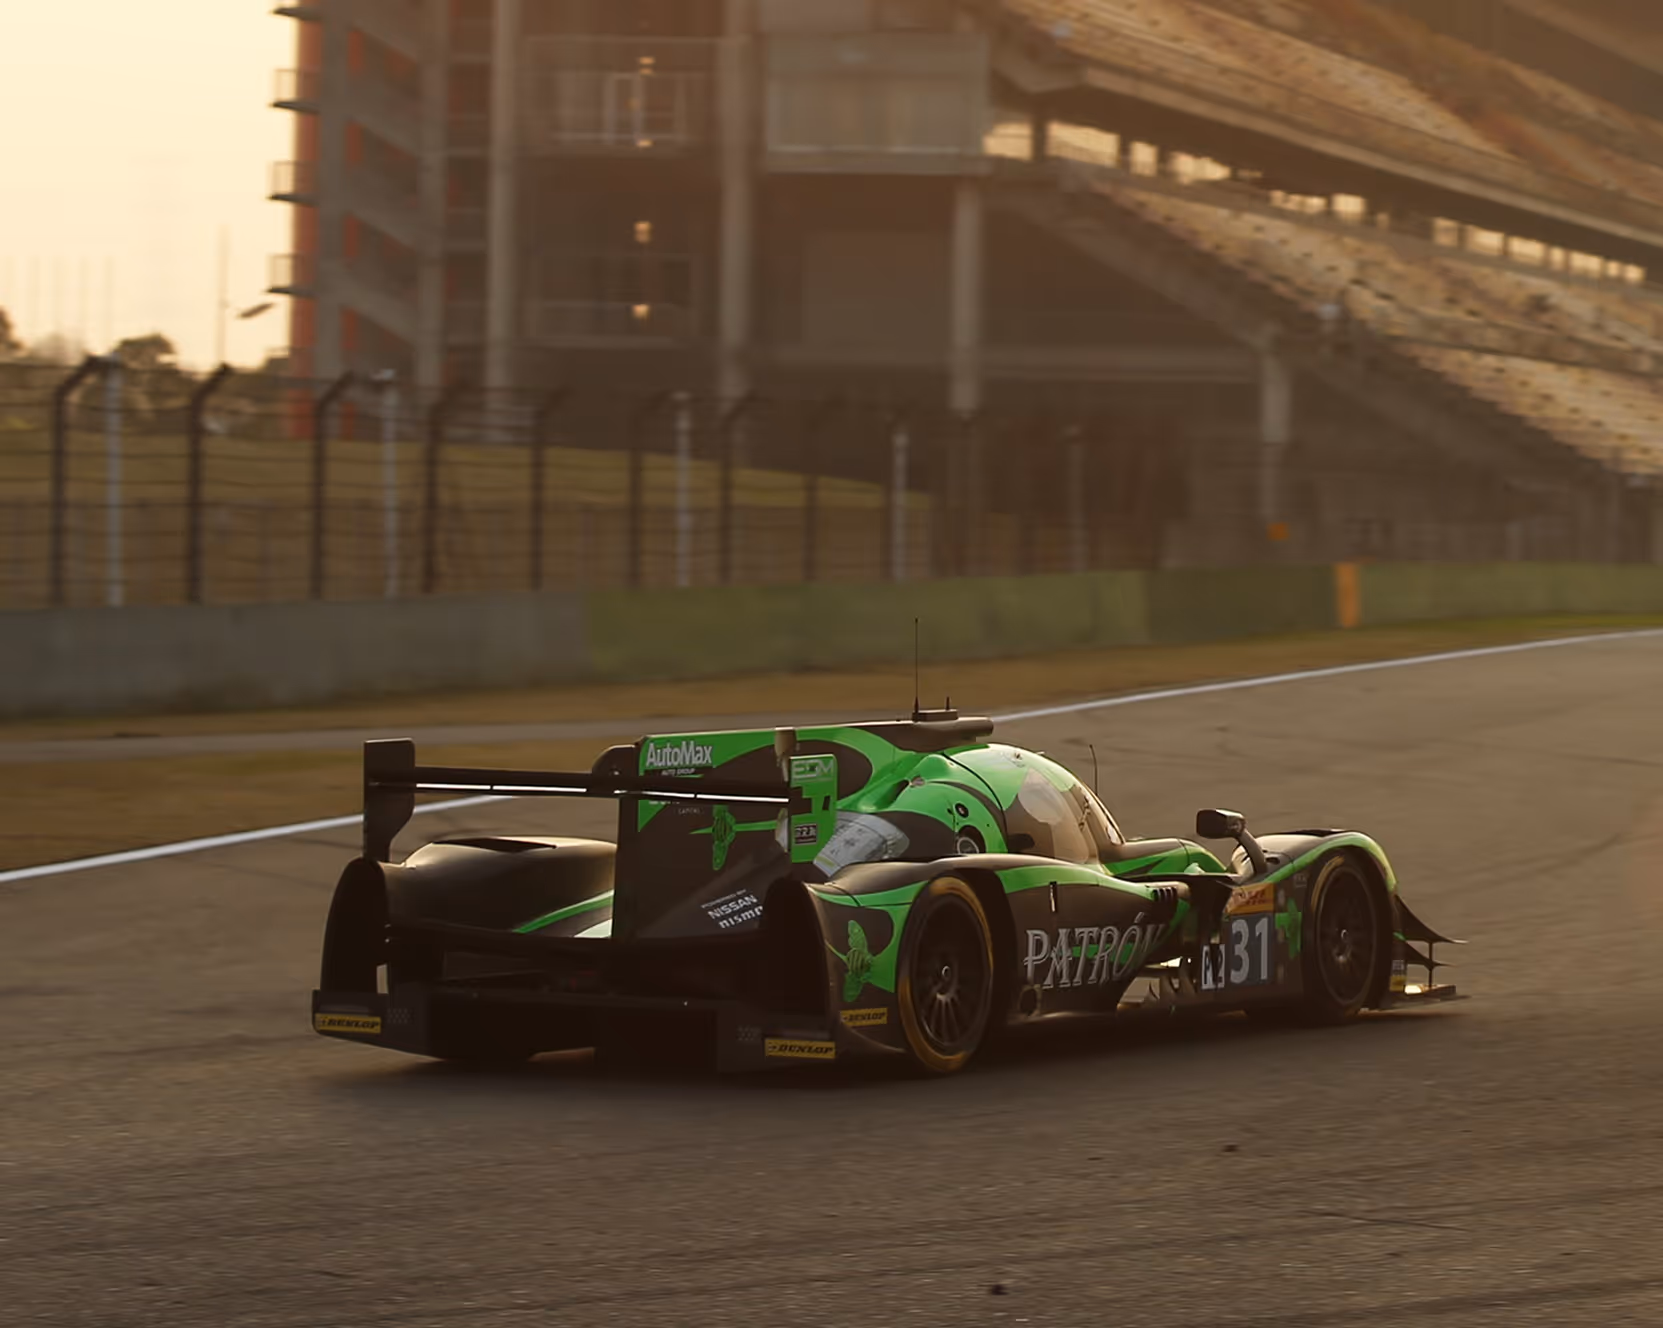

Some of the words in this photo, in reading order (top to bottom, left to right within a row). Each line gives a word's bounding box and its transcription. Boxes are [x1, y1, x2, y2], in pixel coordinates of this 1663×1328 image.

[646, 740, 713, 767] AutoMax
[707, 894, 758, 920] NISSAN
[1230, 916, 1268, 984] 31
[324, 1018, 380, 1029] DUNLOP
[847, 1011, 886, 1022] DUNLOP
[774, 1043, 833, 1055] DUNLOP
